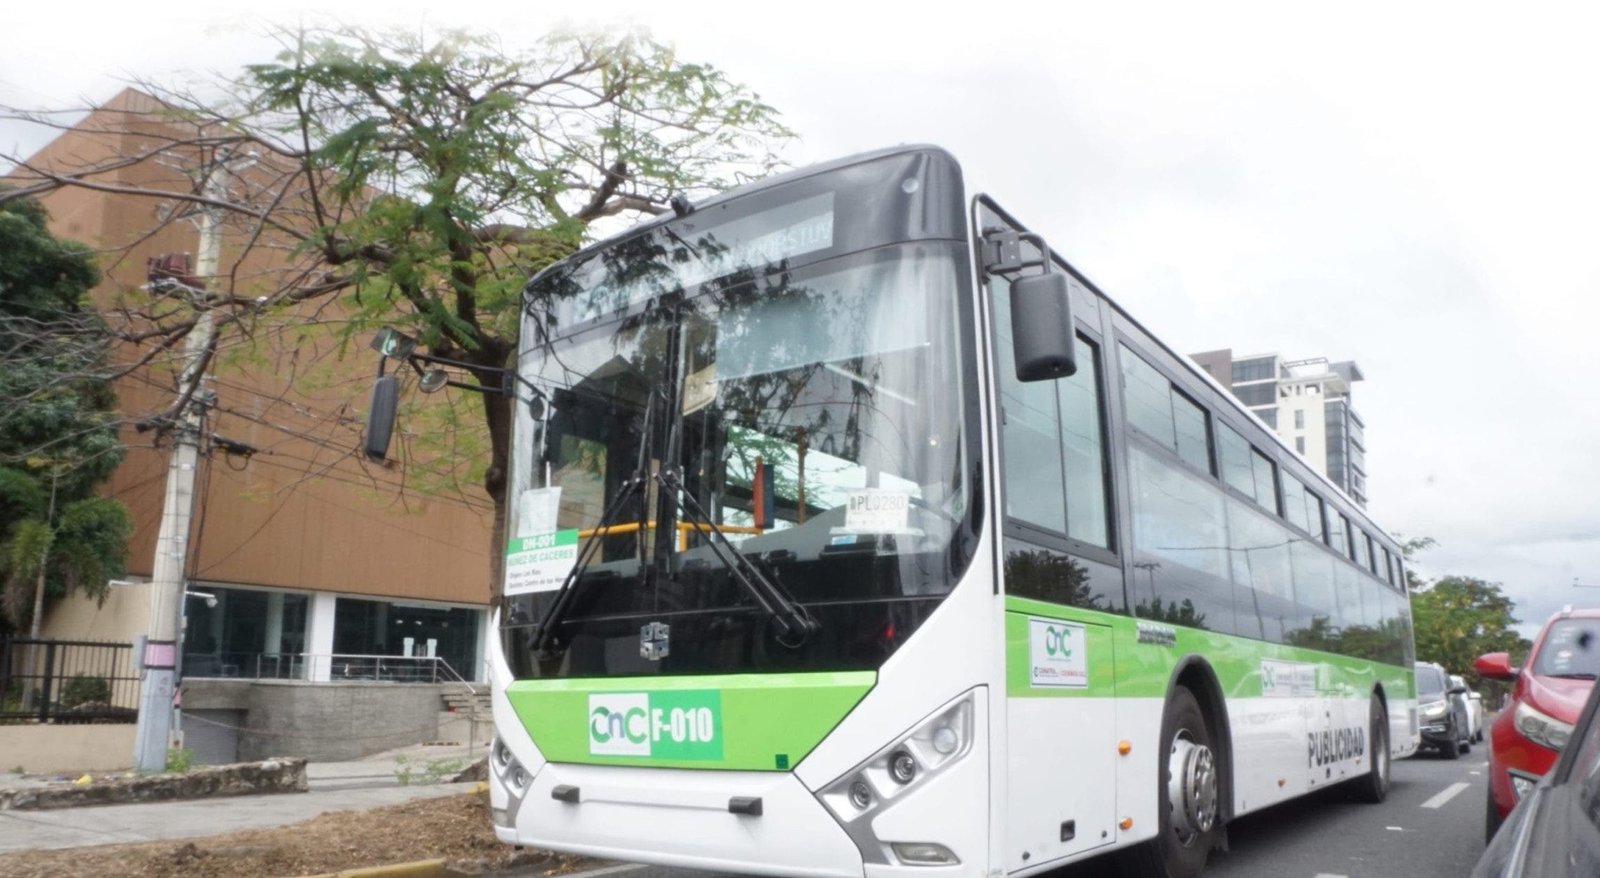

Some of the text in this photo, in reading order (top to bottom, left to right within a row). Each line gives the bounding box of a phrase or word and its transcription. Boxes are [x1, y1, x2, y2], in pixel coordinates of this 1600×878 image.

[522, 533, 556, 551] DN-001
[651, 706, 714, 742] F-010
[1308, 727, 1364, 769] PUBLICIDAD
